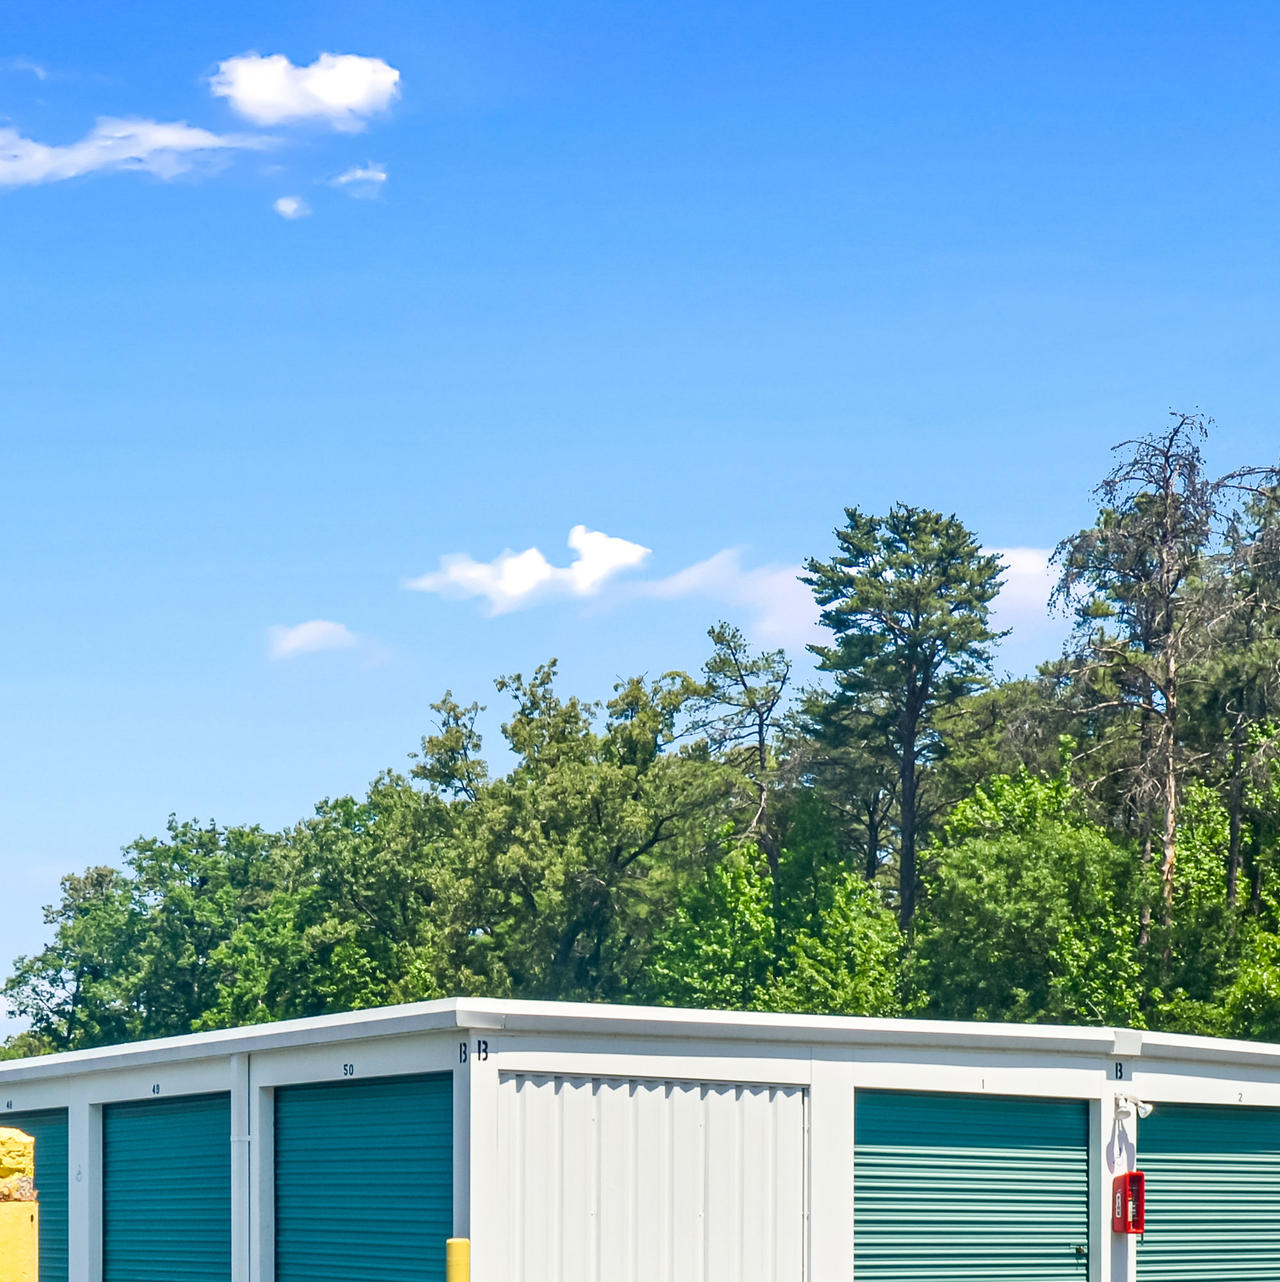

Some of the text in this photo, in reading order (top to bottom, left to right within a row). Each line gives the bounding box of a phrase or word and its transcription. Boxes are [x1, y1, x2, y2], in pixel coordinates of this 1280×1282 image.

[459, 1042, 468, 1063] B
[477, 1040, 489, 1061] B
[343, 1063, 354, 1076] 50
[1115, 1062, 1123, 1080] B
[1238, 1092, 1243, 1103] 2
